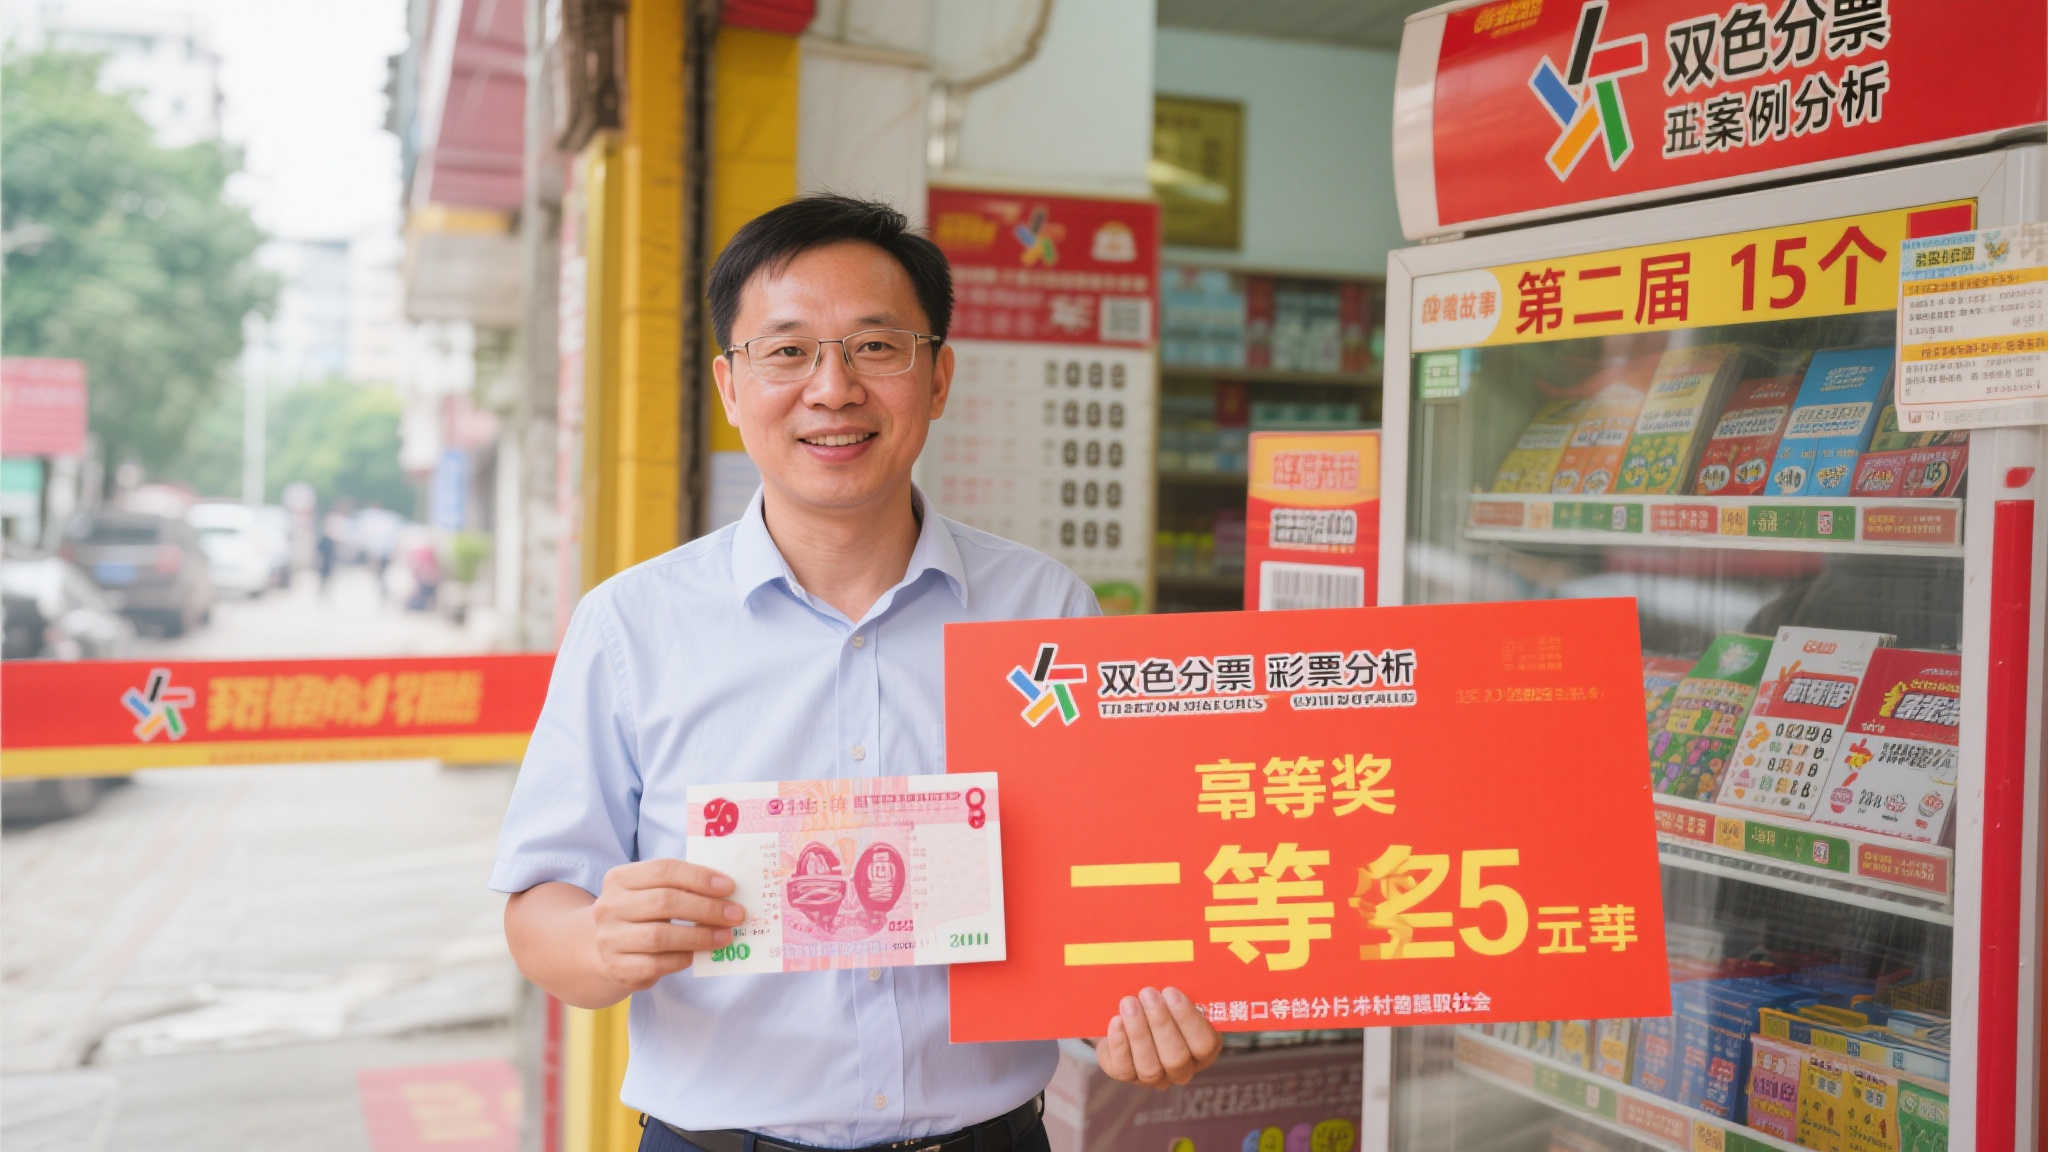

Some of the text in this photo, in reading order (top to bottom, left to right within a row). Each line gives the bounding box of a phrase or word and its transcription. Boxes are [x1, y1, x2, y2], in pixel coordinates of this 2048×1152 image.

[1515, 252, 1691, 335] 第二届
[1730, 225, 1887, 313] 15个
[1100, 650, 1415, 696] 双色分票 彩票分析
